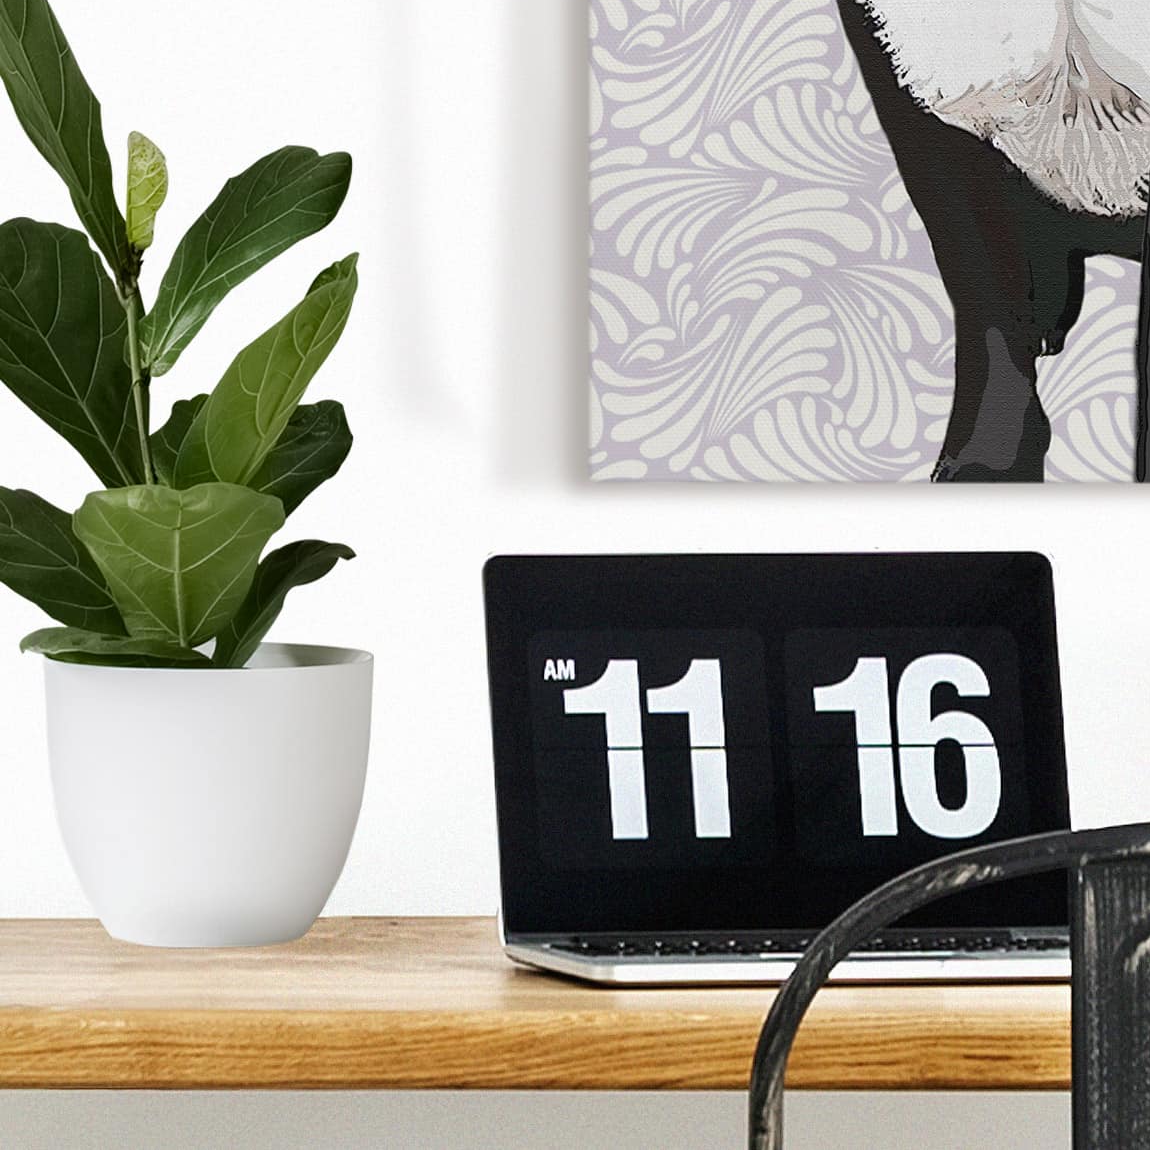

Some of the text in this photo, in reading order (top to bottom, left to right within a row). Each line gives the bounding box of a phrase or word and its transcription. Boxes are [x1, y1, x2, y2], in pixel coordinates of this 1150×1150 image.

[543, 653, 1002, 840] AM 11 16
